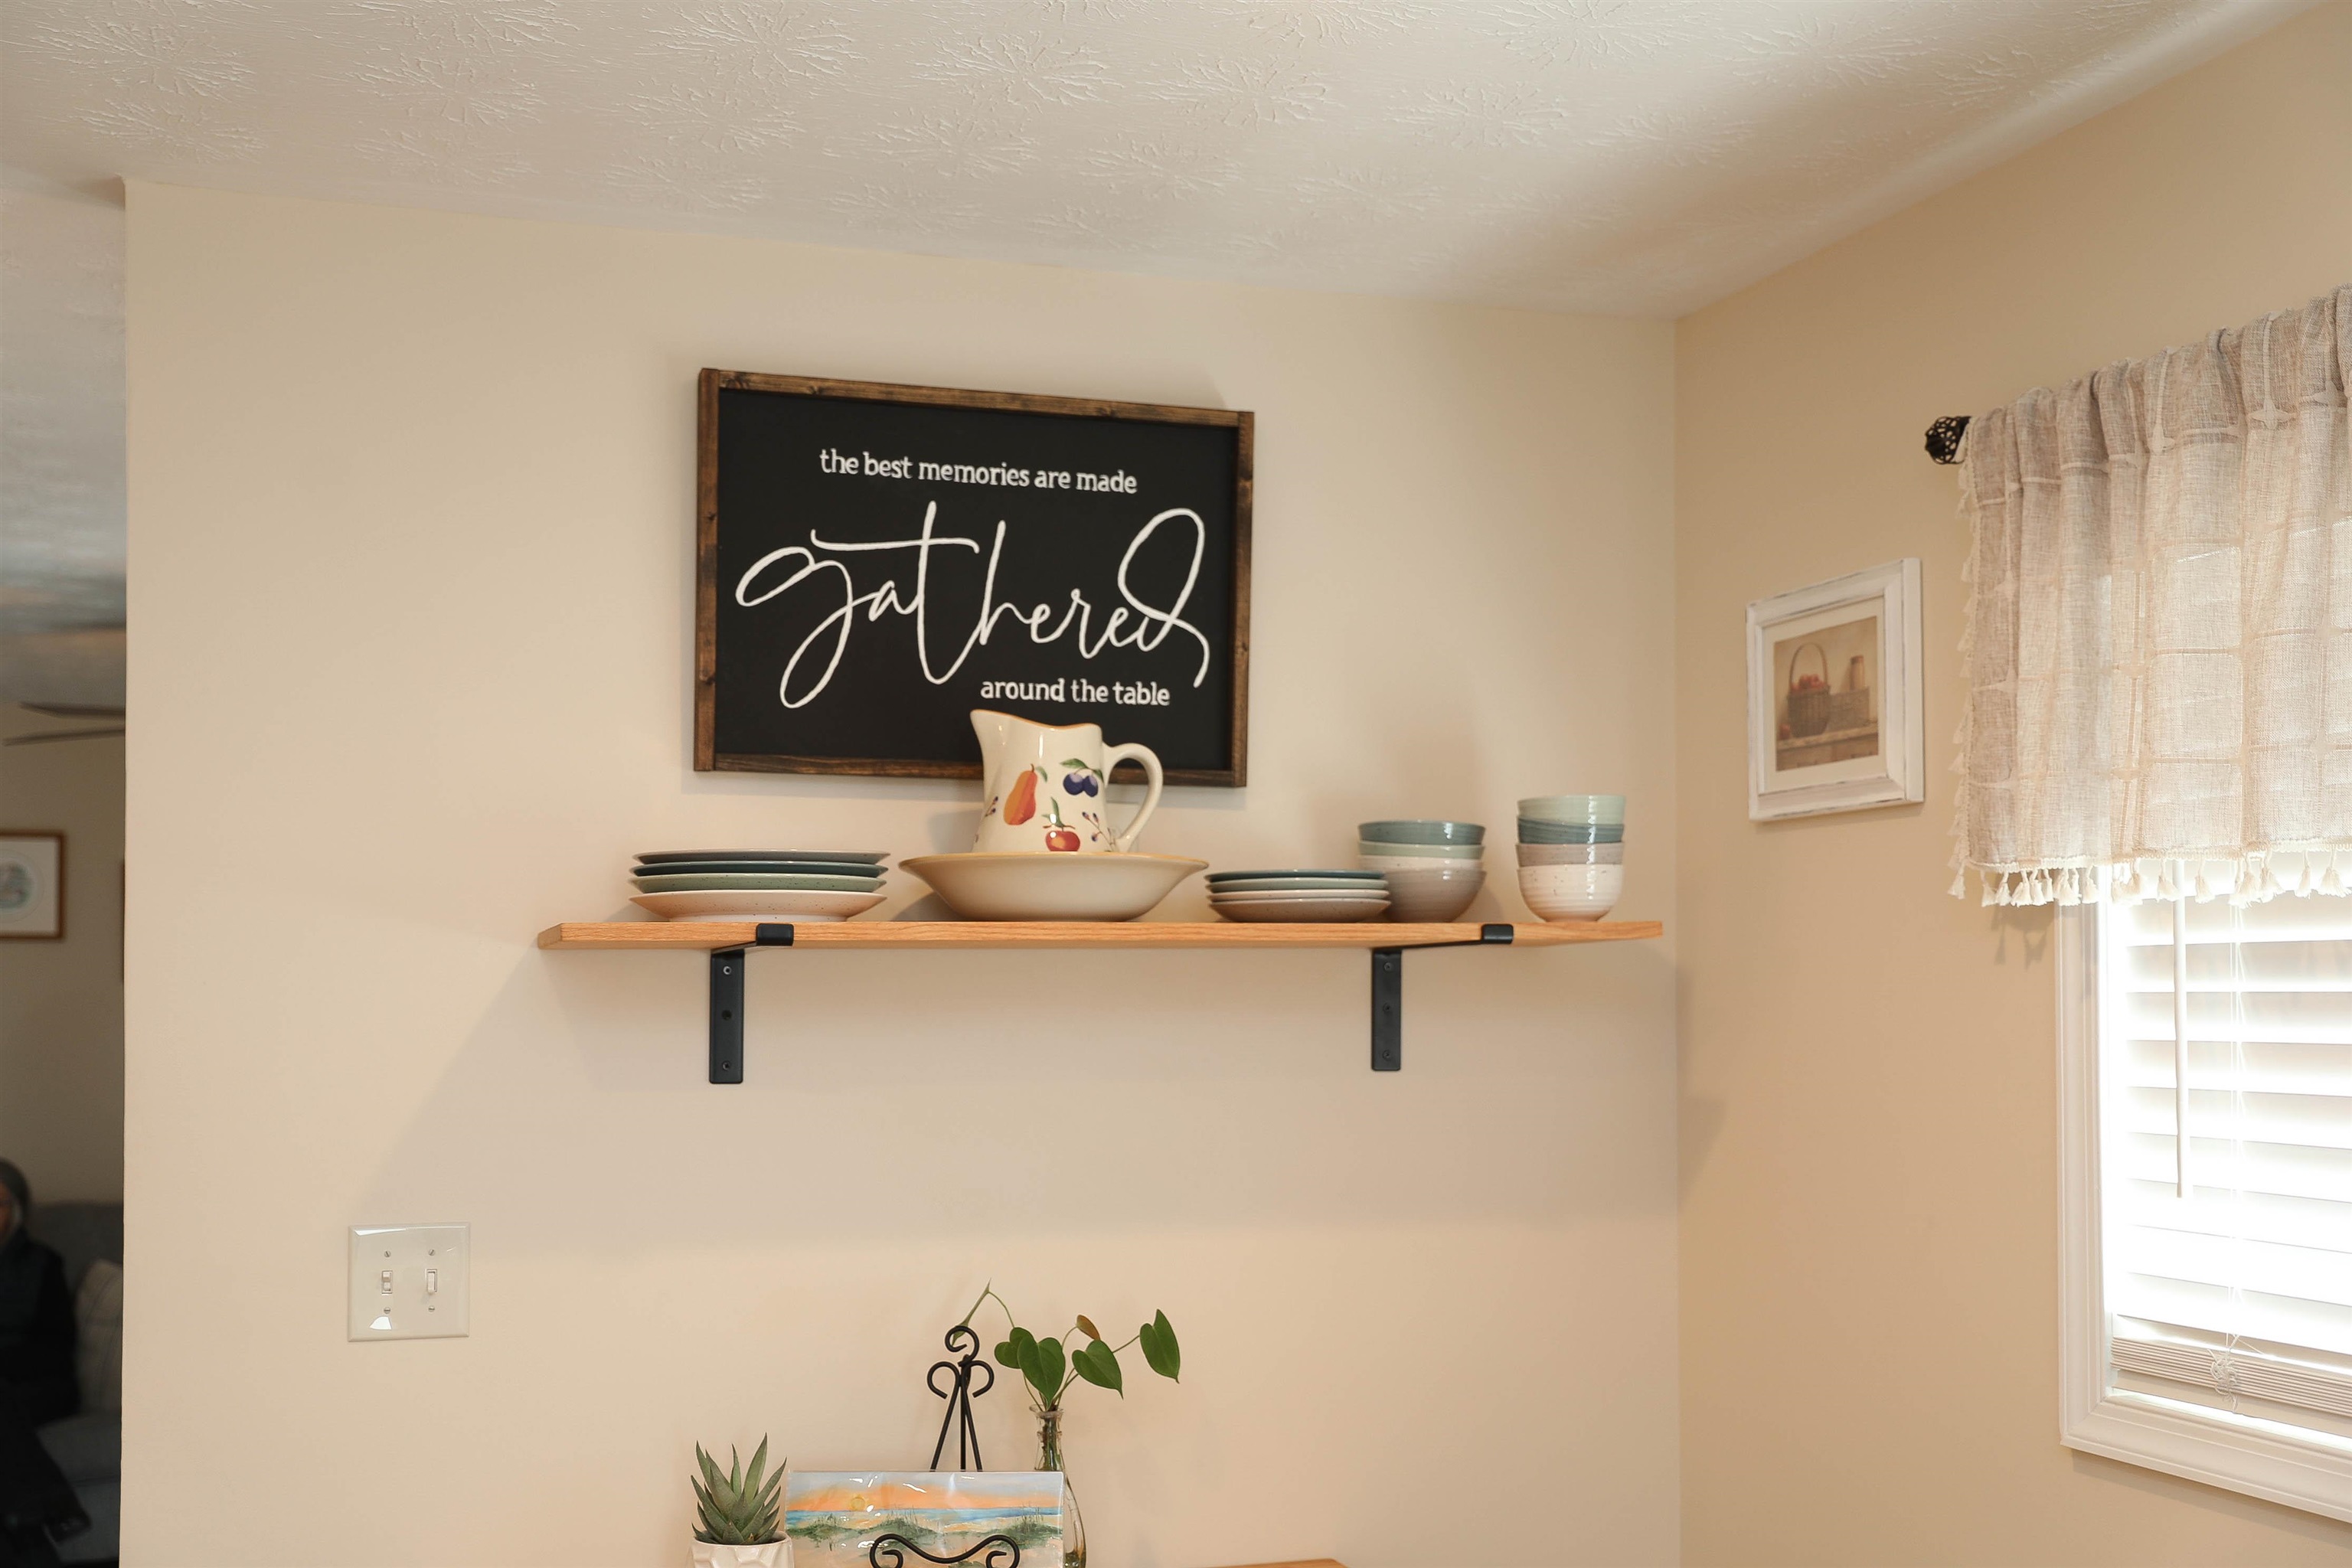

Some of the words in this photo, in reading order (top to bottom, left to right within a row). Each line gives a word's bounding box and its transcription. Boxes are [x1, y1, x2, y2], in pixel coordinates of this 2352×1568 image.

[819, 448, 859, 475] the
[862, 451, 913, 479] best
[918, 462, 1031, 487] memories
[1034, 470, 1071, 489] are
[1076, 469, 1137, 495] made
[735, 500, 1210, 709] gathered
[980, 678, 1066, 703] around
[1070, 679, 1109, 703] the
[1112, 681, 1171, 707] table
